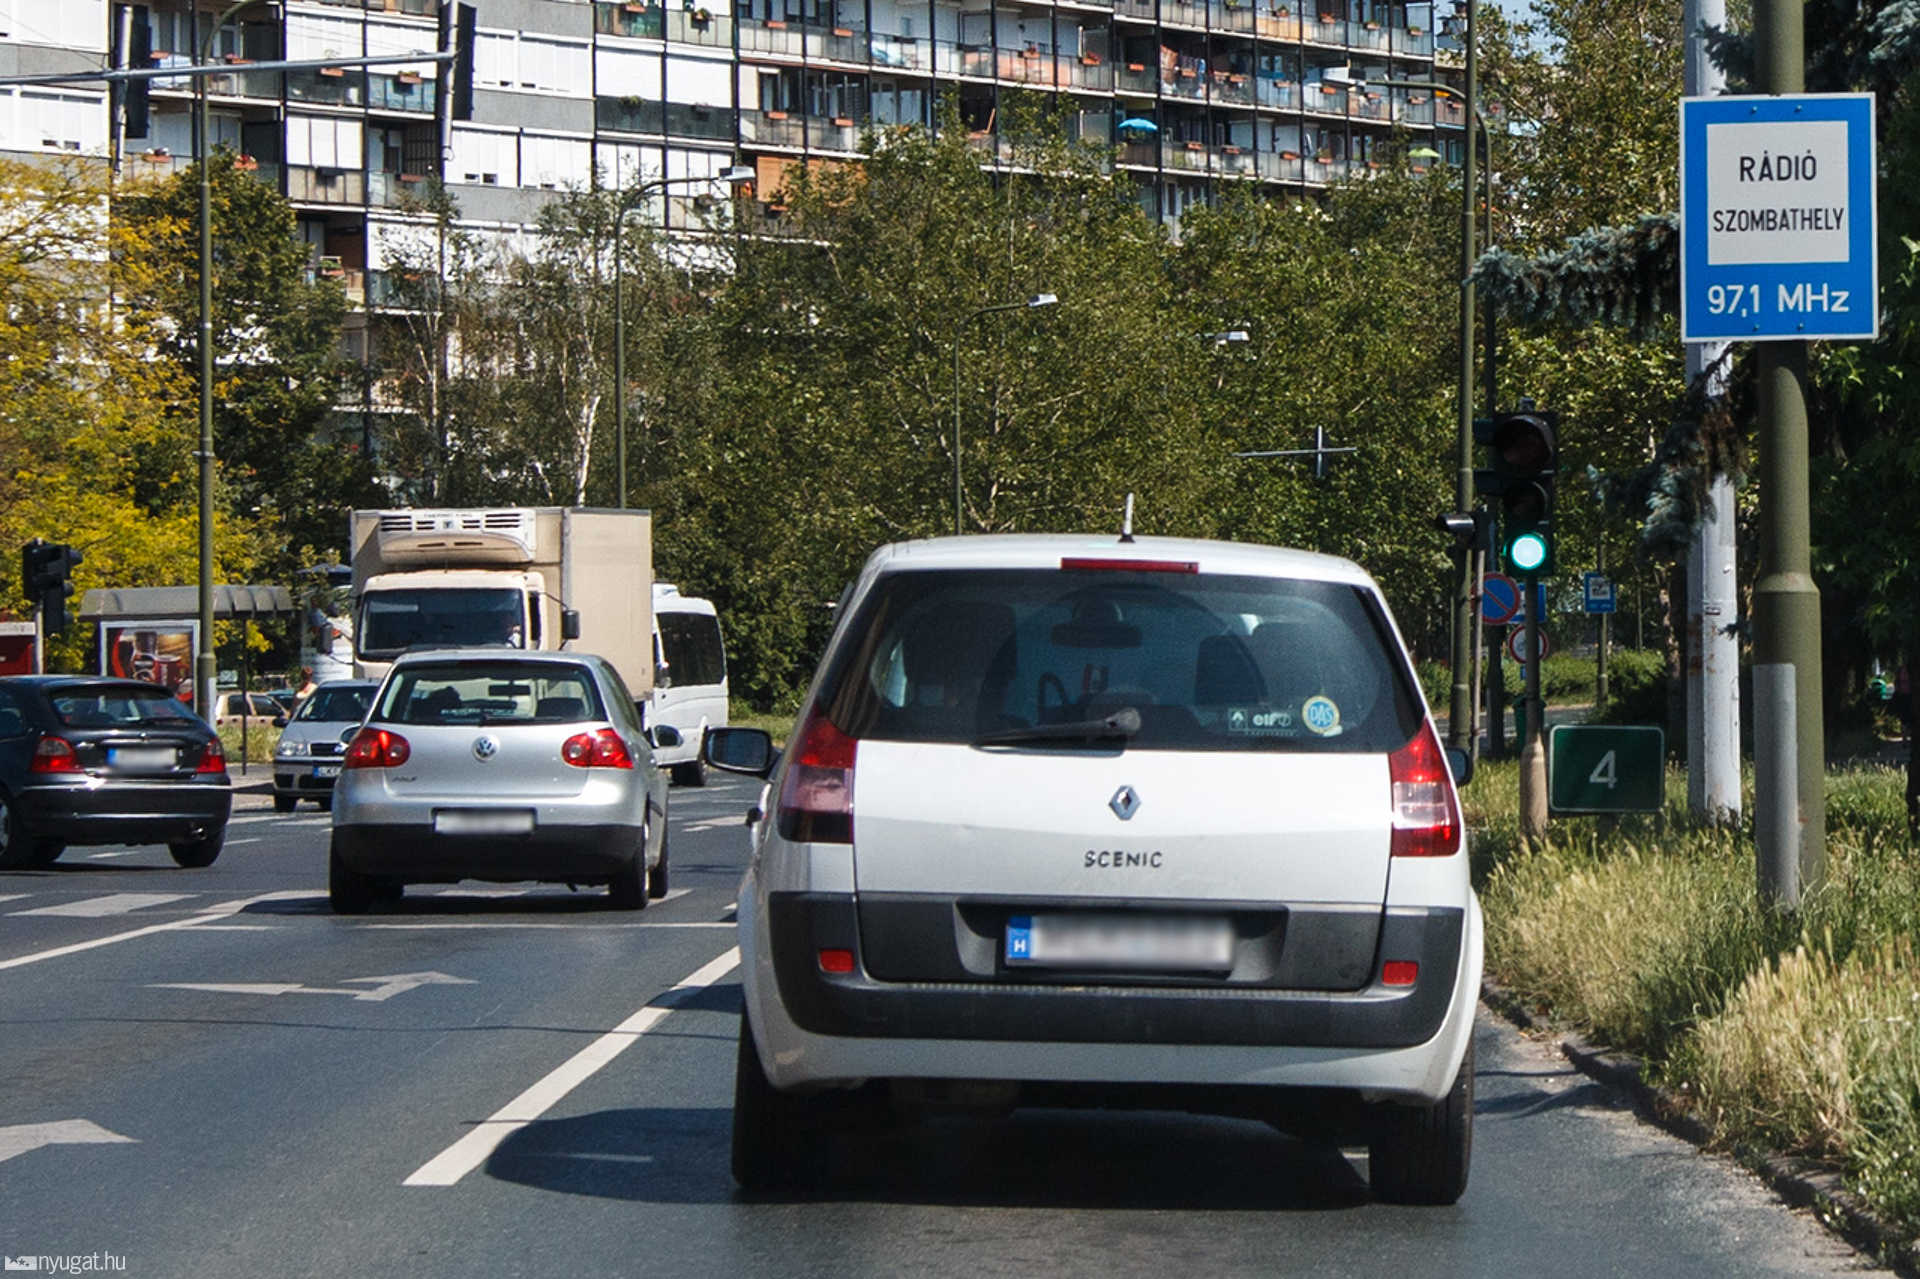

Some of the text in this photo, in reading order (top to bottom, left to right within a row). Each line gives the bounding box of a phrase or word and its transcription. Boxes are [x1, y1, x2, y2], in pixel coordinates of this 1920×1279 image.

[1739, 149, 1817, 182] RÁDIÓ
[1713, 207, 1844, 232] SZOMBATHELY
[1707, 283, 1849, 318] 97,1 MHz
[1589, 750, 1617, 789] 4
[1084, 850, 1163, 868] SCENIC
[1013, 939, 1026, 953] H
